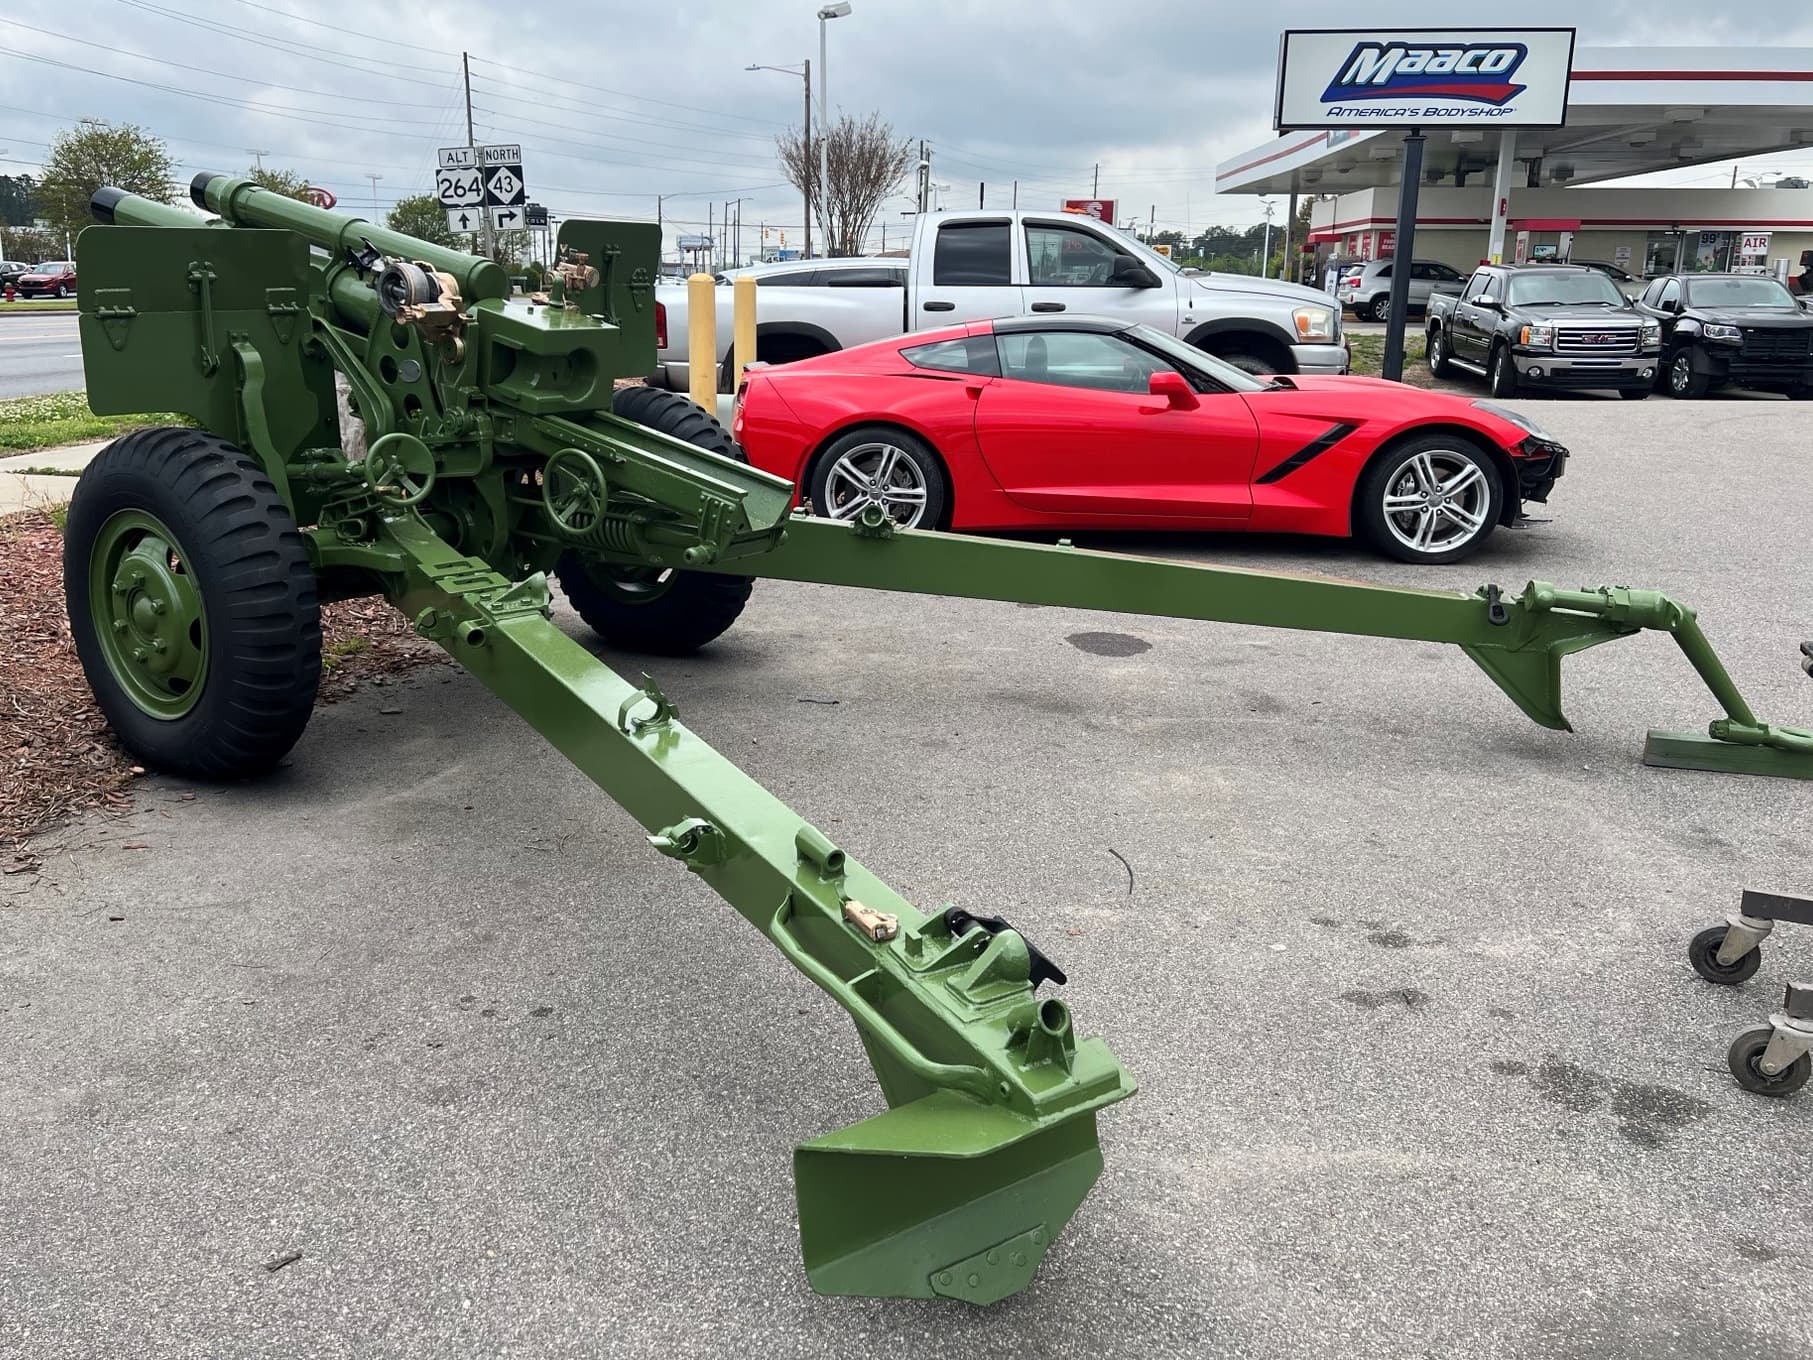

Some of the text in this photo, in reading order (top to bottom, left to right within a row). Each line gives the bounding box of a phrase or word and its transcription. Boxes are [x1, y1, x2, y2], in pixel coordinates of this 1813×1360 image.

[1341, 48, 1519, 86] Maaco
[1326, 106, 1420, 117] AMERICA'S
[446, 151, 469, 164] ALT
[485, 149, 519, 161] NORTH
[440, 175, 482, 199] 264
[493, 175, 514, 194] 43
[1743, 237, 1767, 248] AIR
